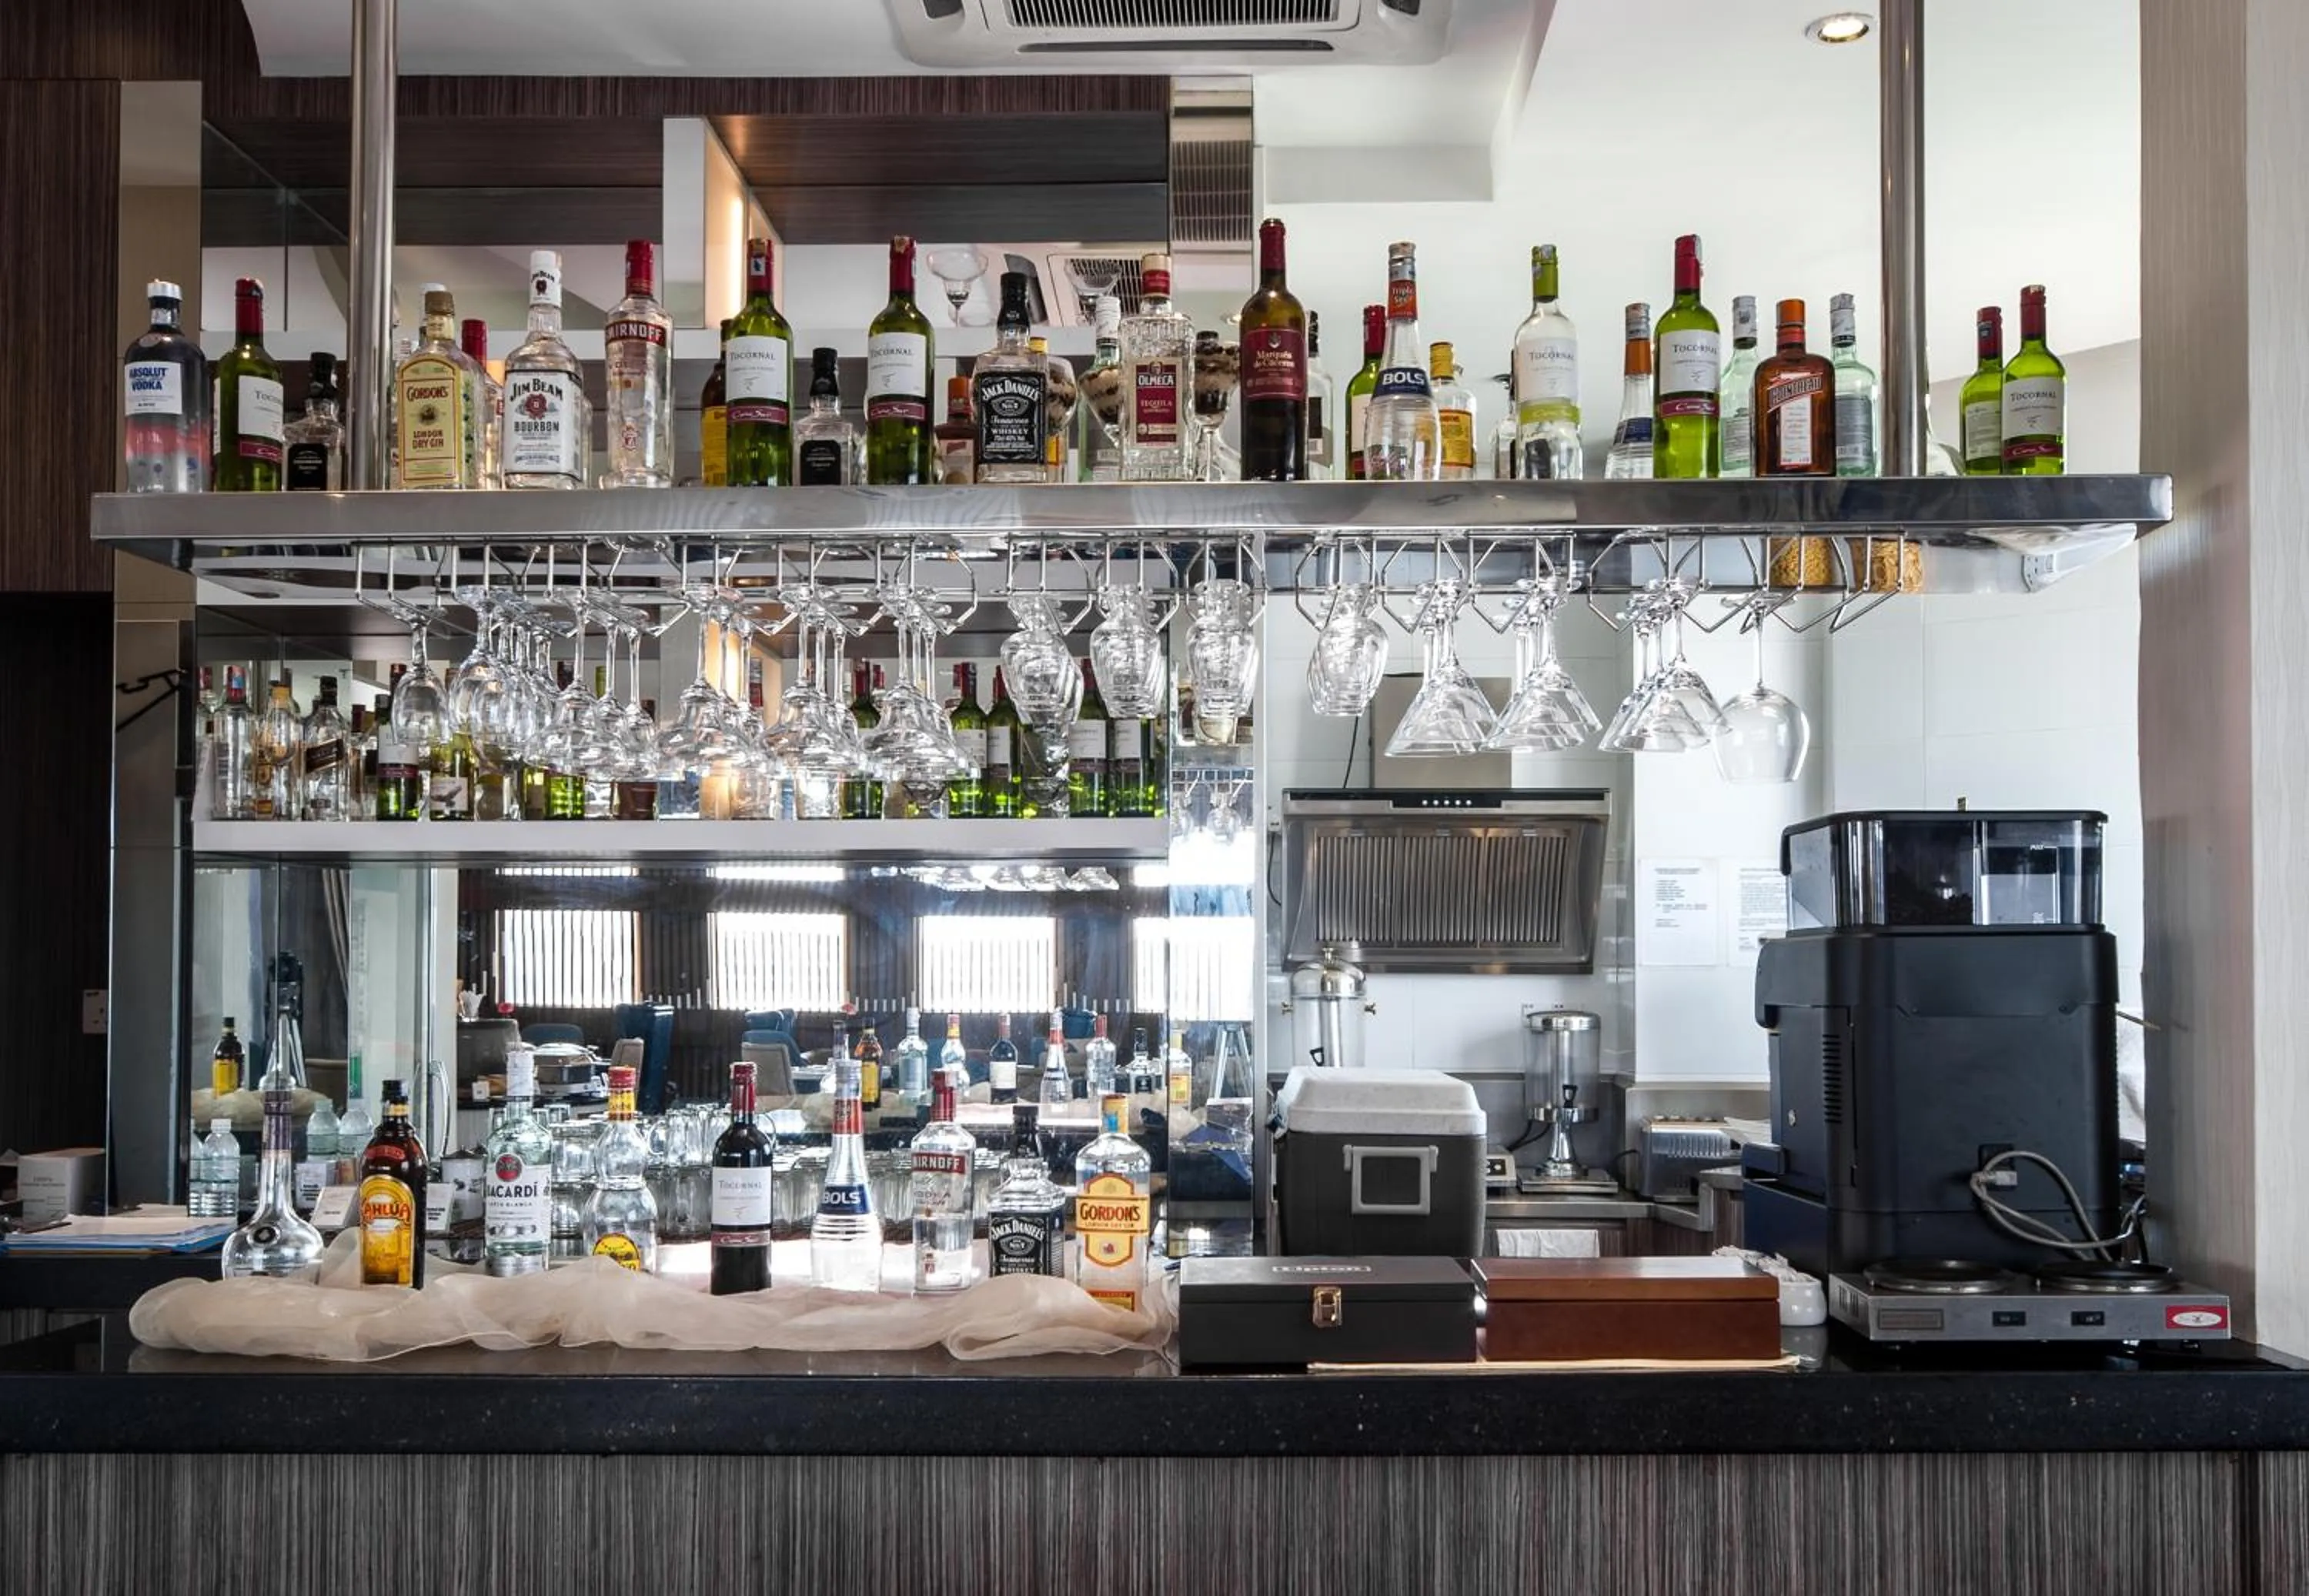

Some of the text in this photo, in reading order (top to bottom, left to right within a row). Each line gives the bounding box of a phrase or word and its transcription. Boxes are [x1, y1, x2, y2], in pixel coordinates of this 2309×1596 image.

[129, 367, 168, 379] ABSOLUT
[1382, 372, 1425, 386] BOLS
[132, 380, 162, 392] VODKA
[1138, 375, 1174, 386] OLMECA
[510, 378, 563, 402] JIM BEAM
[981, 379, 1041, 402] JACK DANIEL'S
[1141, 399, 1173, 409] TEQUILA
[513, 420, 560, 432] BOURBON
[413, 429, 443, 439] LONDON
[413, 438, 445, 449] DRY GIN
[823, 1191, 861, 1205] BOLS
[991, 1223, 1012, 1240] JACK
